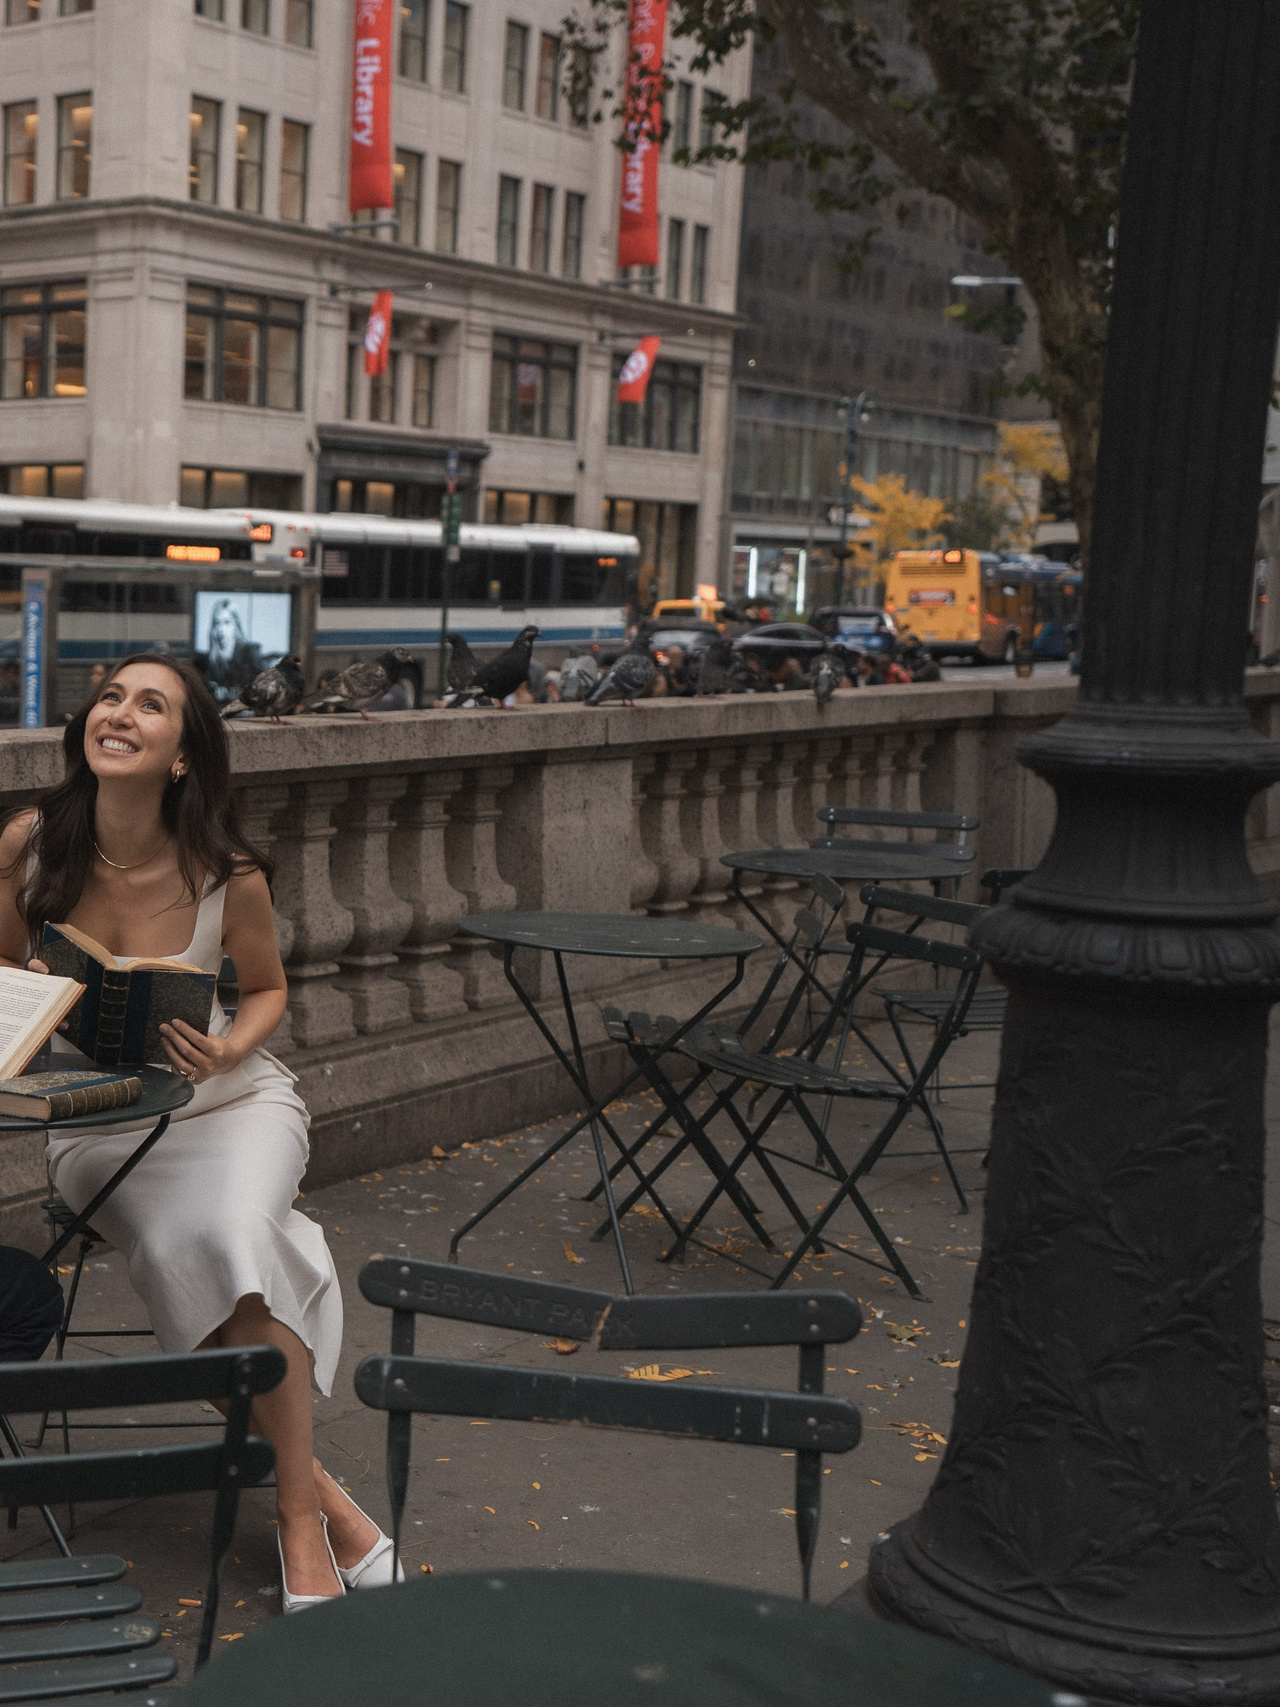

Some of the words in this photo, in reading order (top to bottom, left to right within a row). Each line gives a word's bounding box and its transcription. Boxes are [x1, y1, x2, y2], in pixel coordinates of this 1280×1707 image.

[351, 37, 381, 147] Library
[26, 612, 39, 661] Avenue
[418, 1278, 542, 1319] BRYANT
